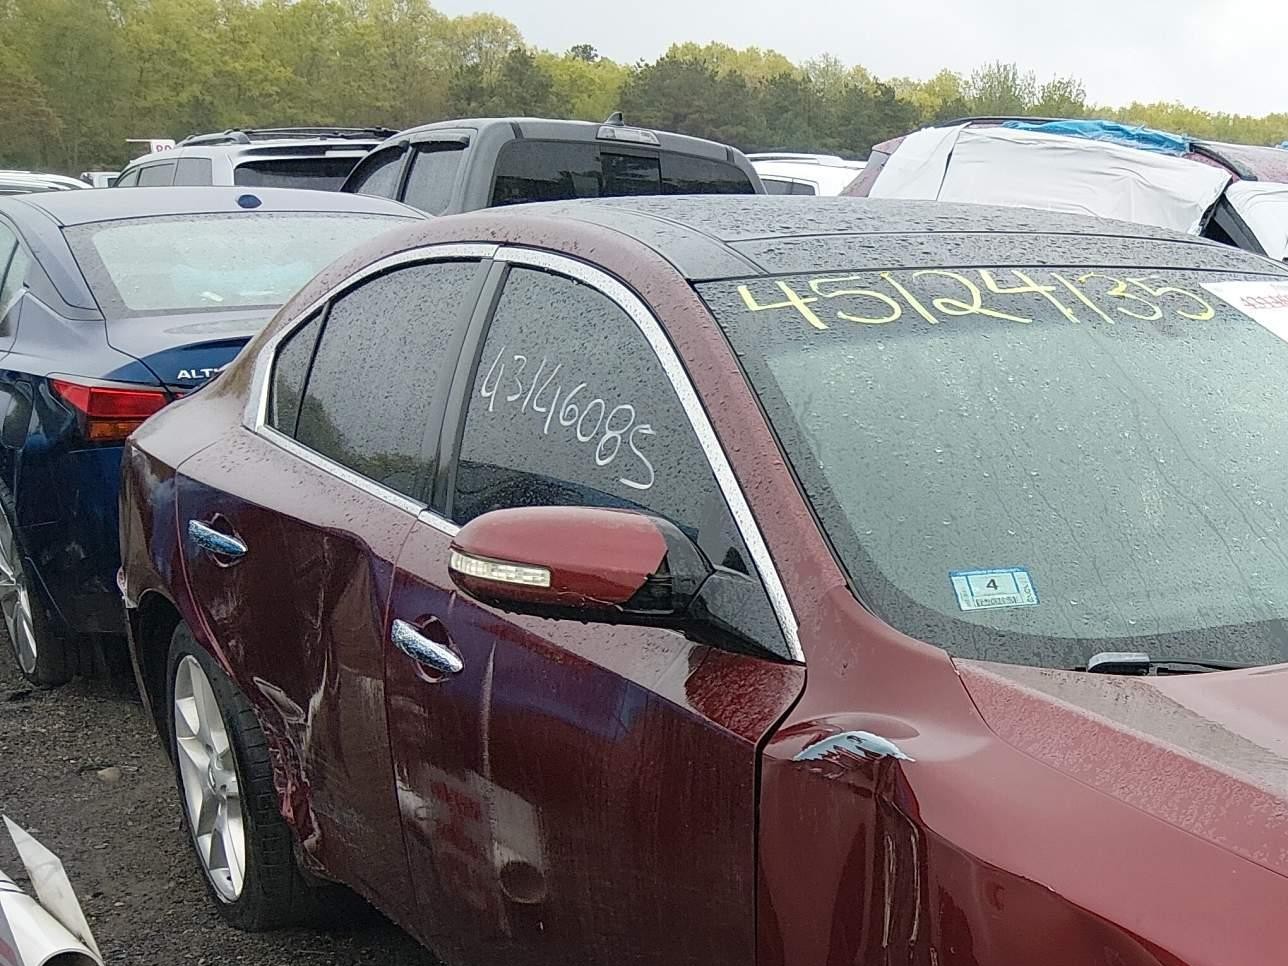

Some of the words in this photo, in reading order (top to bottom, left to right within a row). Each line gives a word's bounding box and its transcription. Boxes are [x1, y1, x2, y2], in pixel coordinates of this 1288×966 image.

[737, 268, 1215, 330] 45124135
[481, 345, 656, 490] 43146085
[986, 578, 998, 590] 4
